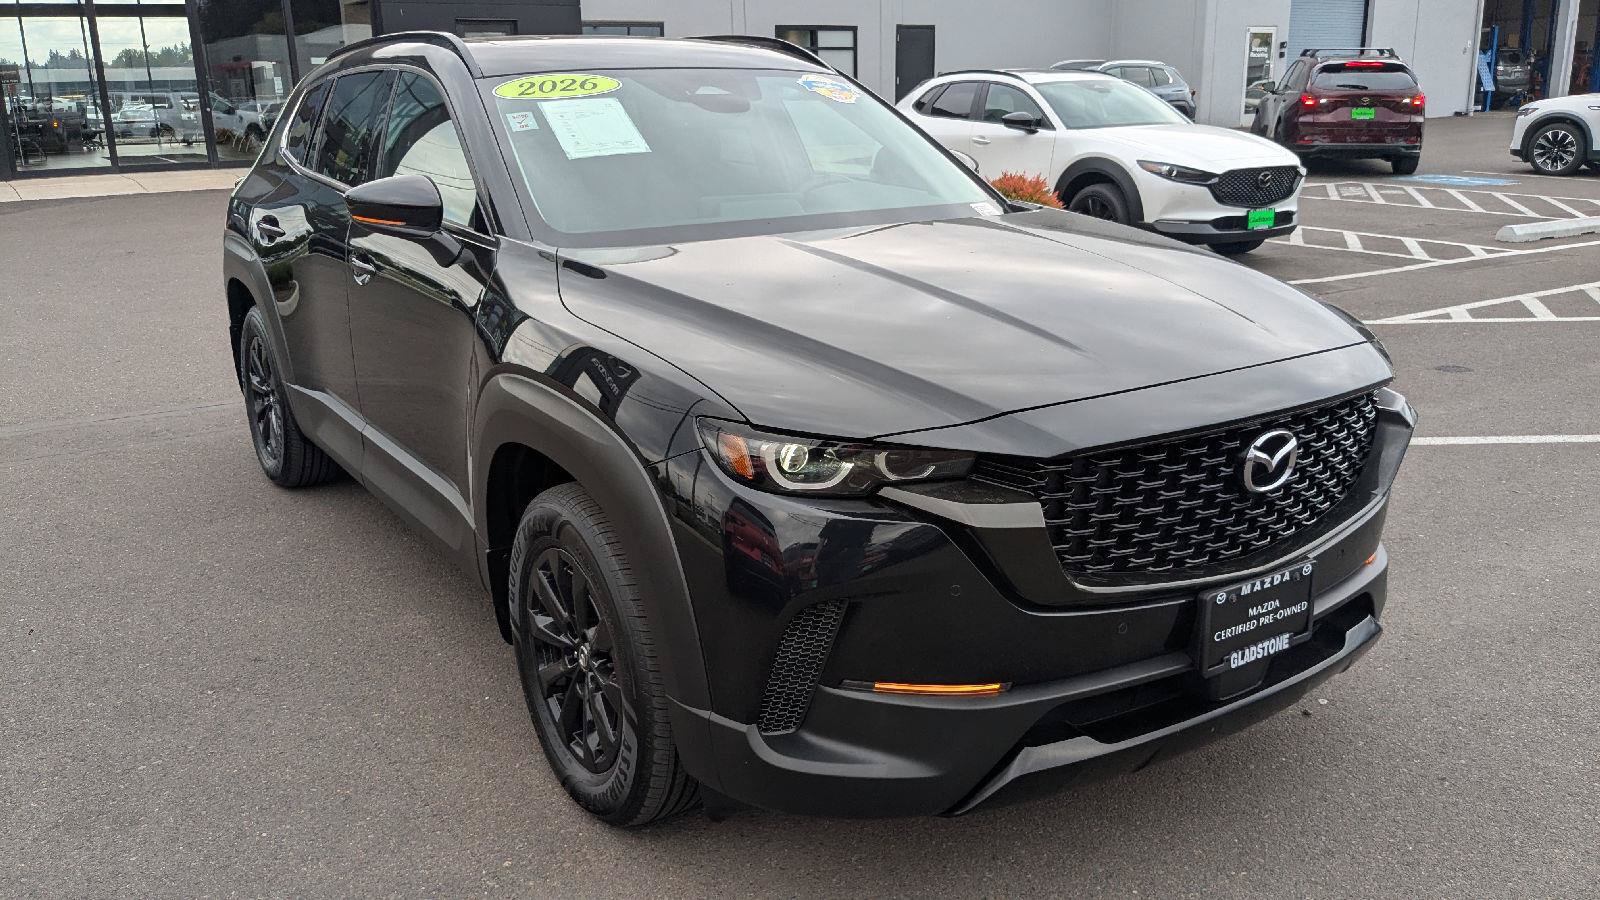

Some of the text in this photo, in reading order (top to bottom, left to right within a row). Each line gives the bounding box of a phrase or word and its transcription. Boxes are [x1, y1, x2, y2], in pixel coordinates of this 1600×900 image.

[518, 77, 598, 97] 2026
[1240, 571, 1291, 596] MAZDA
[1248, 598, 1280, 617] MAZDA
[1214, 601, 1308, 642] CERTIFIED PRE-OWNED
[1230, 633, 1291, 669] GLADSTONE
